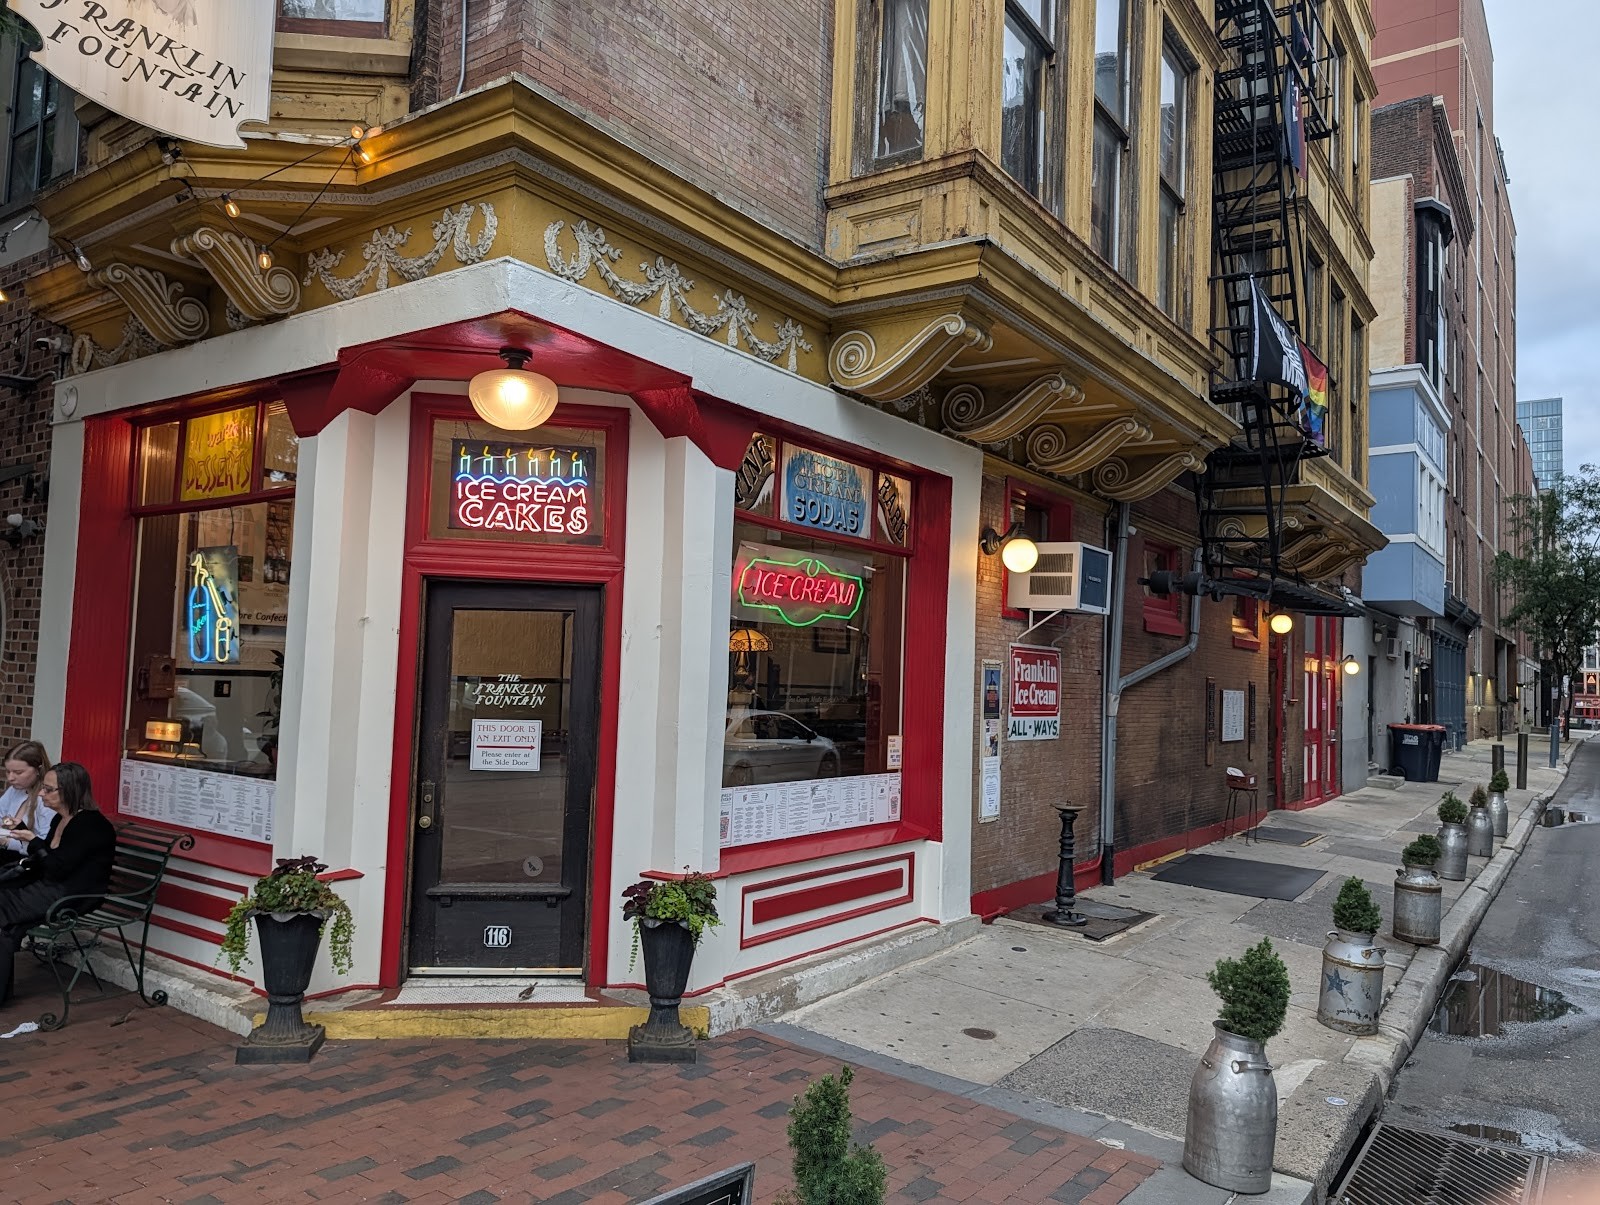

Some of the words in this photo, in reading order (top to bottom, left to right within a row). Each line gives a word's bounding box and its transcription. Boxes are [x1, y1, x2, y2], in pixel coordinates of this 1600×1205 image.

[40, 0, 247, 90] RANKLIN
[47, 19, 244, 119] FOUNTAIN
[186, 450, 250, 493] DESSERTS
[812, 460, 847, 484] ICE
[457, 481, 497, 500] ICE
[502, 483, 587, 504] CREAM
[794, 473, 860, 504] CREAM
[458, 499, 588, 535] CAKES
[794, 495, 859, 534] SODAS
[753, 569, 788, 599] ICE
[789, 574, 855, 606] CREAM
[497, 673, 522, 682] THE
[1014, 657, 1057, 683] Franklin
[472, 683, 547, 696] FRANKLIN
[474, 695, 546, 708] FOUNTAIN
[1014, 683, 1029, 705] Ice
[1028, 683, 1057, 706] Cream
[476, 724, 497, 733] THIS
[499, 724, 525, 733] DOOR
[528, 725, 536, 733] IS
[476, 734, 489, 742] AN
[493, 735, 512, 743] EXIT
[514, 735, 537, 744] ONLY
[487, 928, 508, 946] 116
